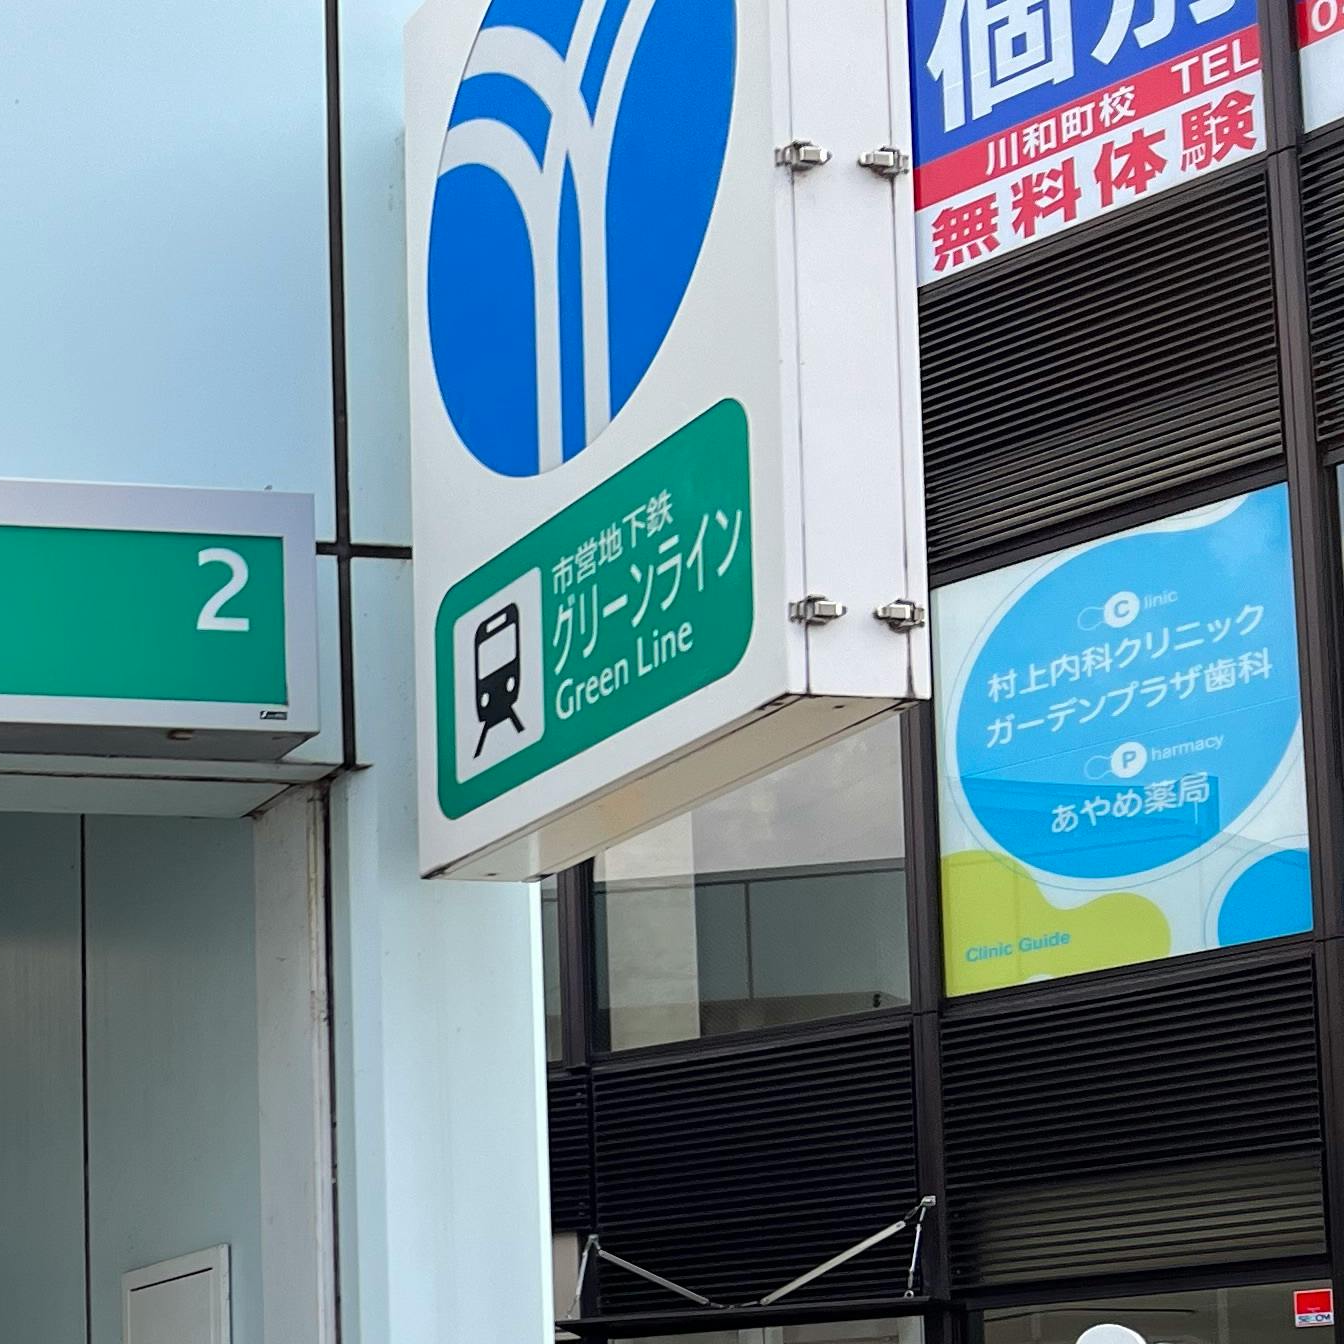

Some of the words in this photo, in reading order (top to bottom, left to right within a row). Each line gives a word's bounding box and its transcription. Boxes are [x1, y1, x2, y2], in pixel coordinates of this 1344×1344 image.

[985, 86, 1137, 176] 川和町校
[1171, 39, 1259, 94] TEL
[931, 89, 1259, 272] 無料体験
[197, 548, 250, 632] 2
[551, 489, 673, 595] 市営地下鉄
[552, 509, 743, 676] グリーンライン
[555, 658, 630, 720] Green
[636, 621, 694, 678] Line
[985, 648, 1273, 749] ガーデンプラザ歯科
[986, 604, 1265, 702] 村上内科クリニック
[1050, 771, 1210, 834] あやめ薬局
[965, 943, 1013, 963] Clinic
[1018, 931, 1071, 953] Guide
